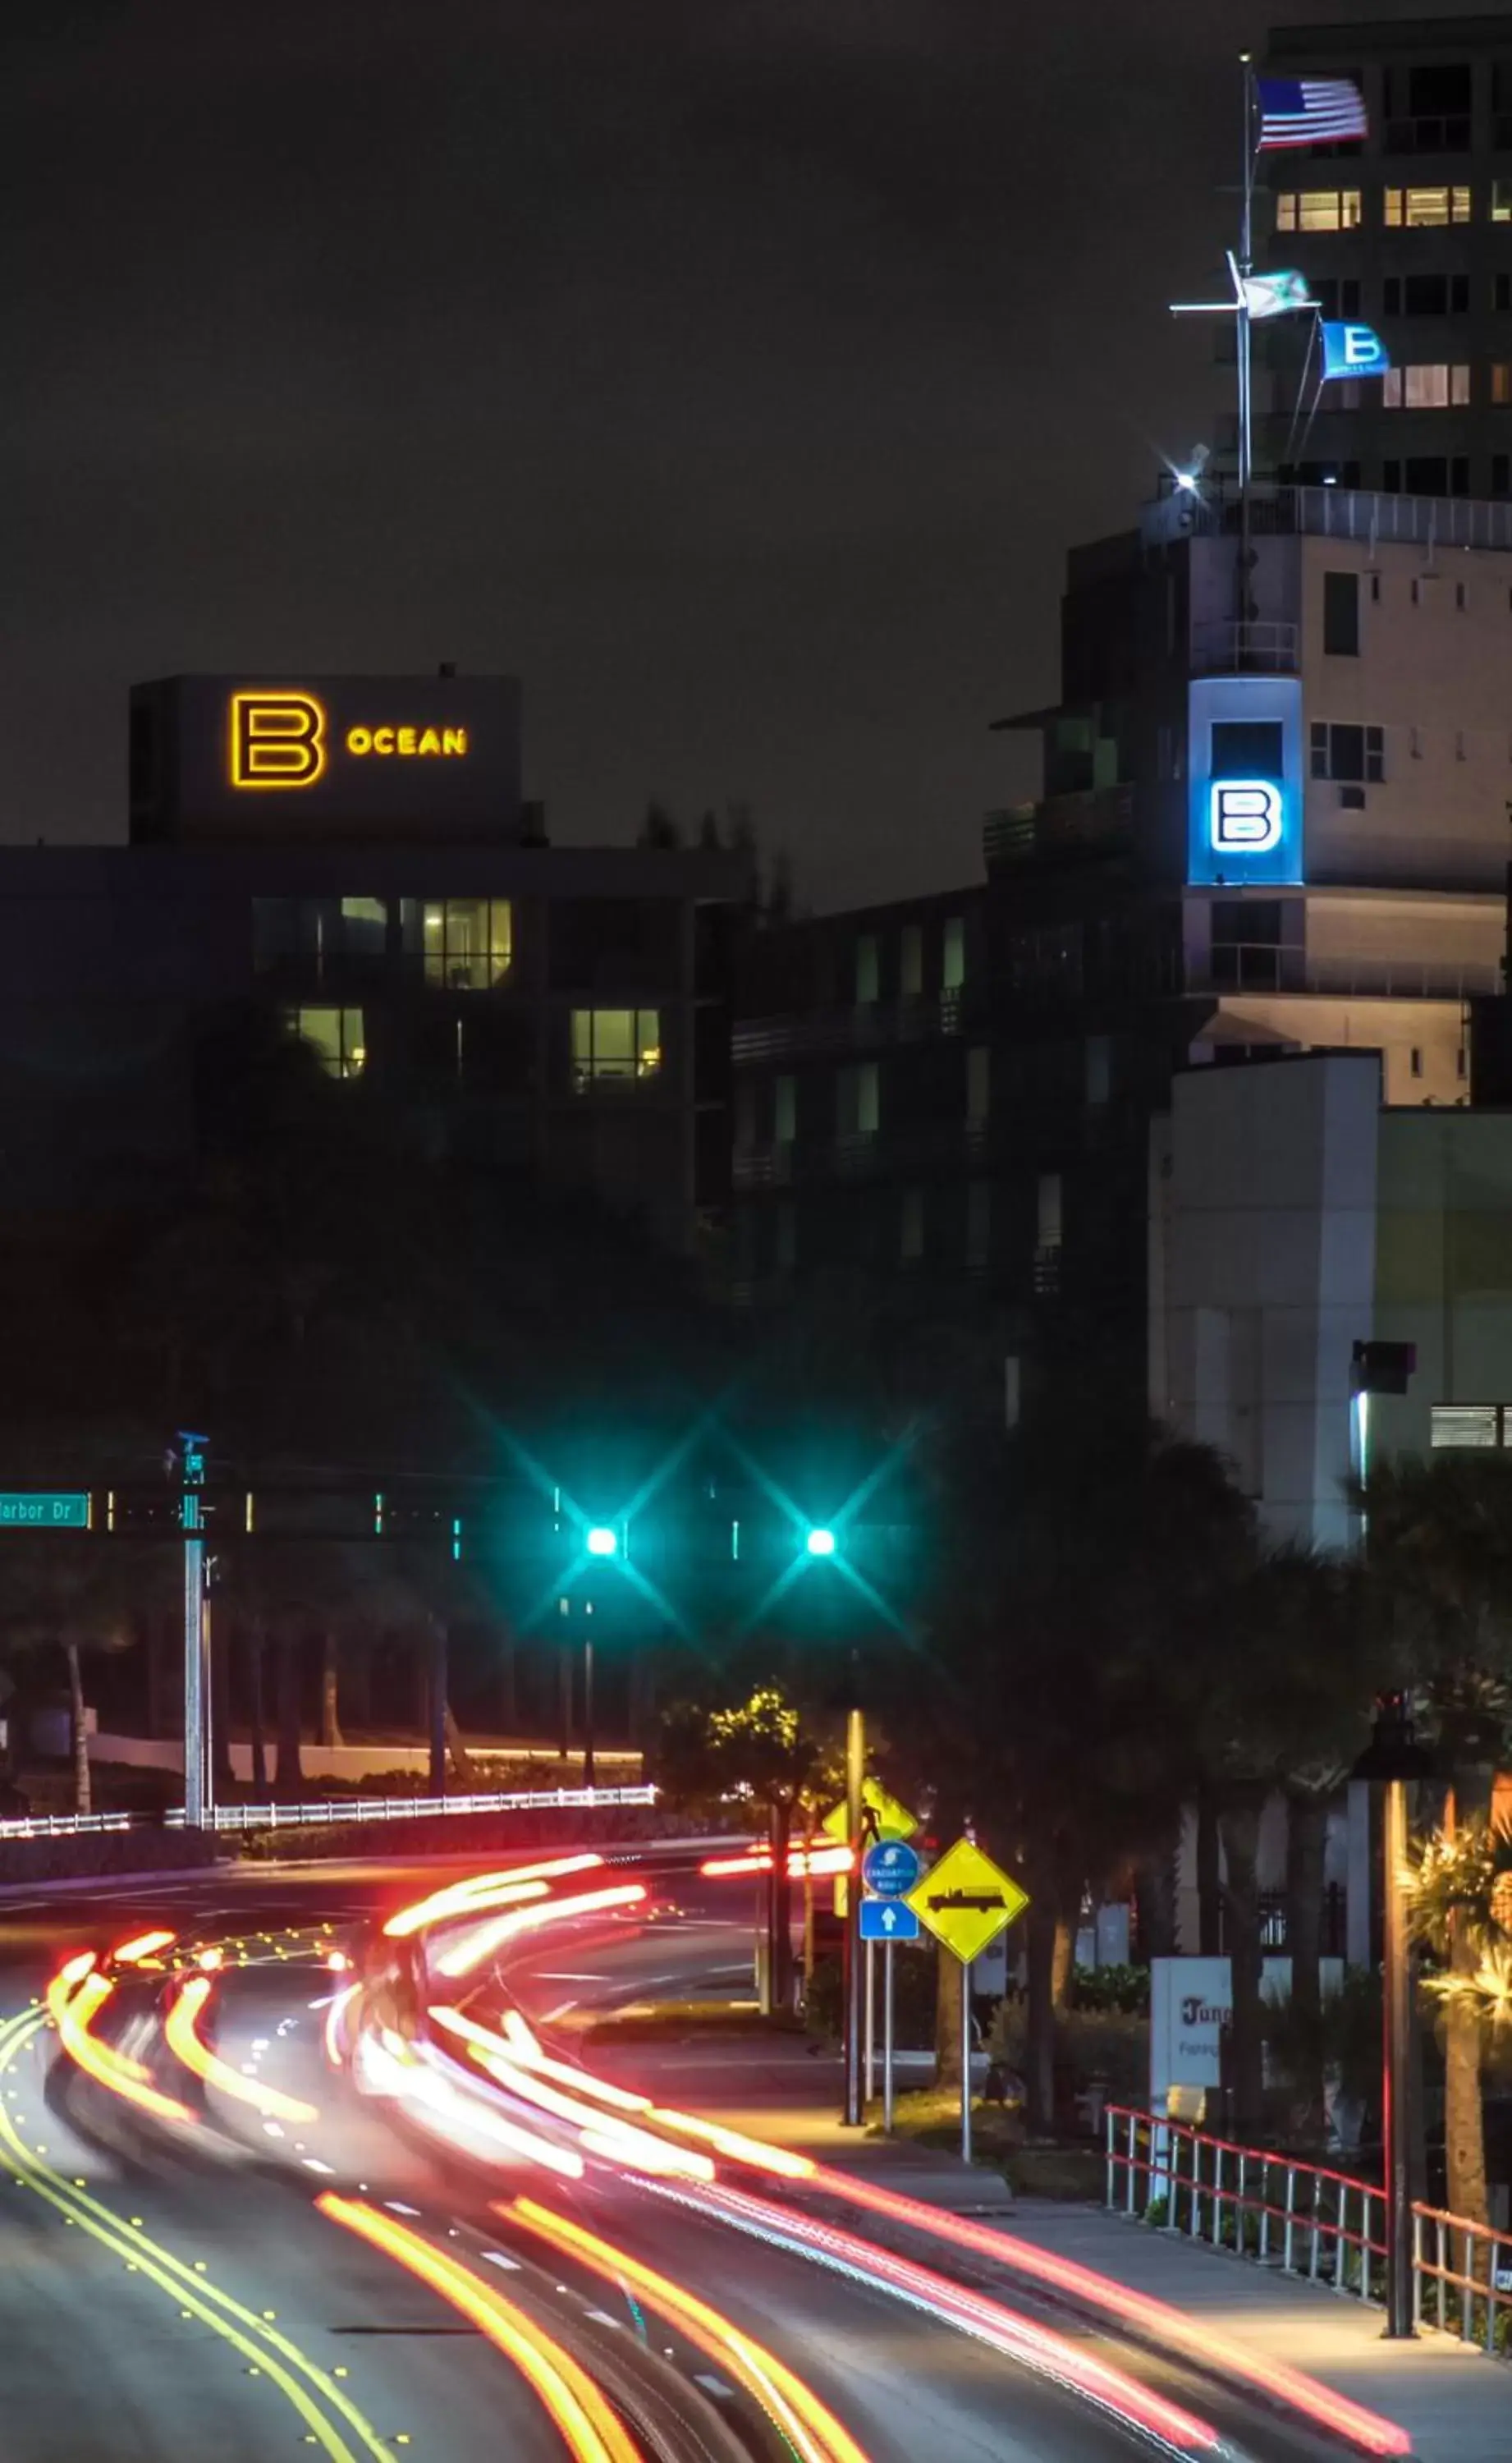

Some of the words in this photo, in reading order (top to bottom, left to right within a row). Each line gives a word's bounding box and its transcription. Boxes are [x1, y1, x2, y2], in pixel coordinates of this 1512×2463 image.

[1345, 327, 1380, 364] B
[232, 693, 324, 786] B
[346, 727, 465, 754] OCEAN
[1214, 785, 1276, 847] B
[53, 1502, 71, 1520] Dr
[1182, 1997, 1234, 2030] Jung
